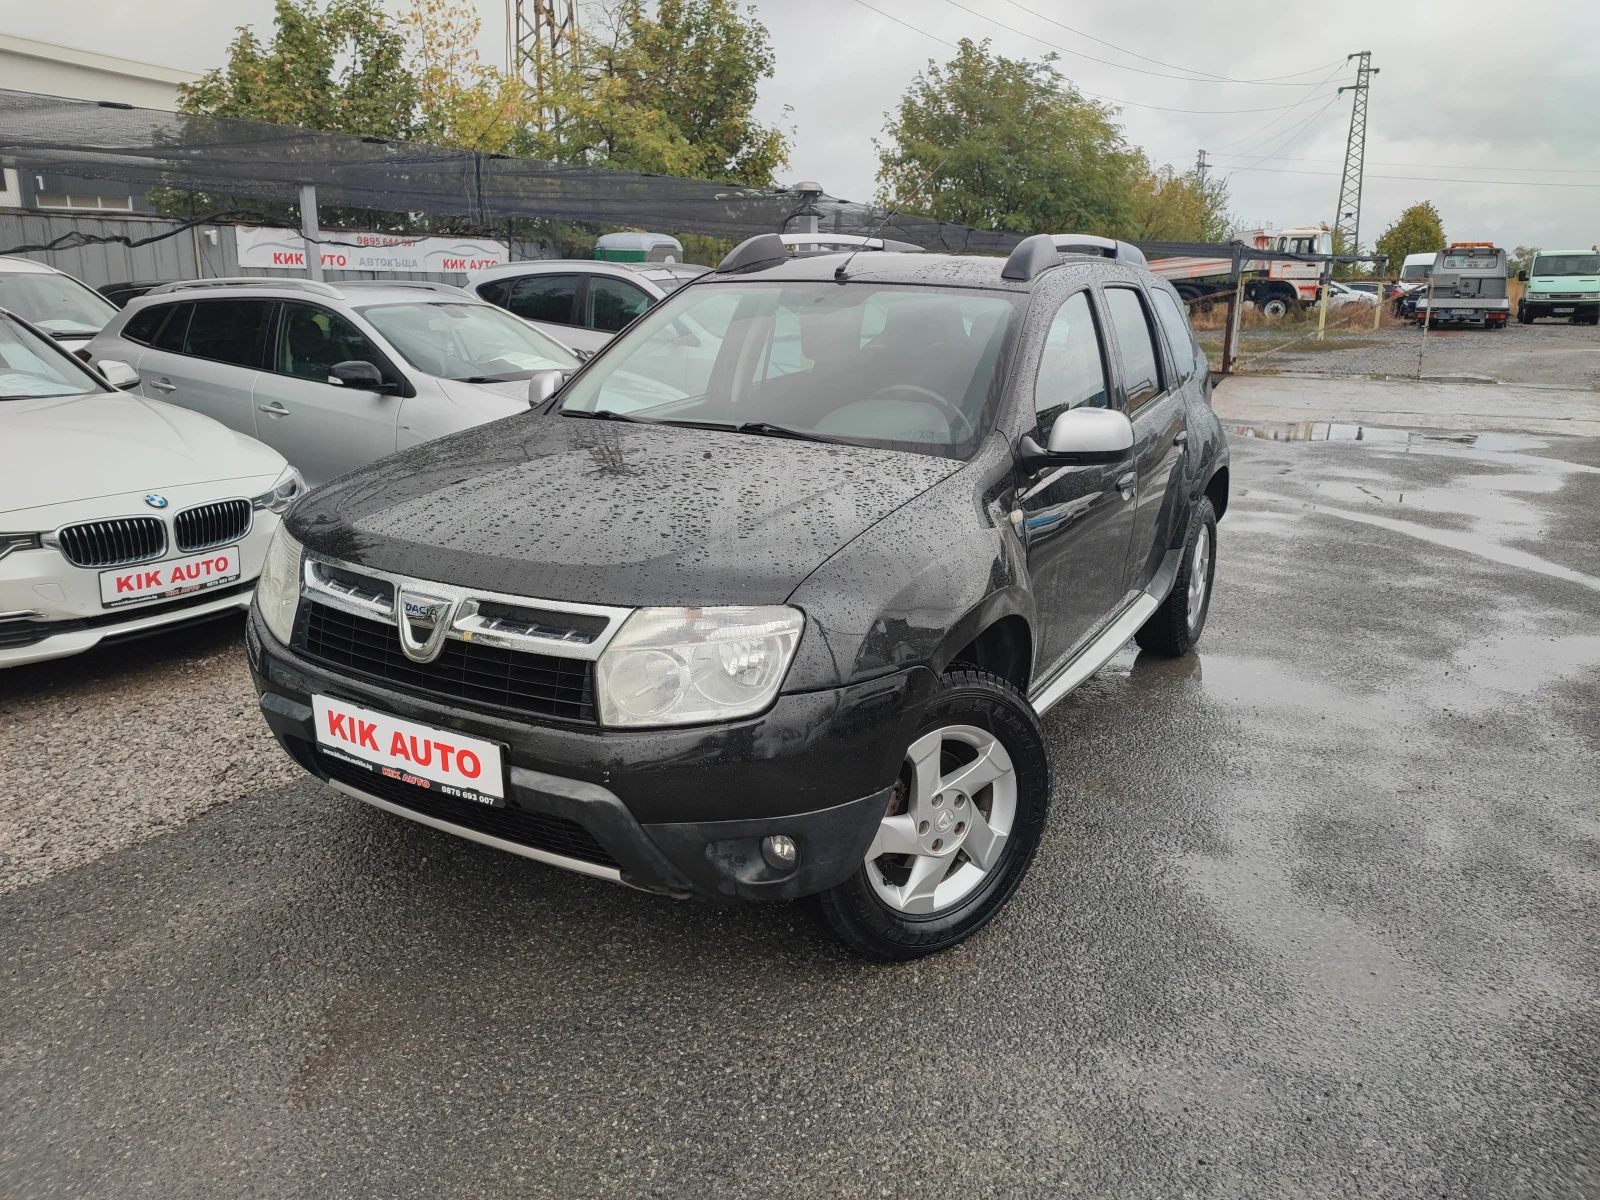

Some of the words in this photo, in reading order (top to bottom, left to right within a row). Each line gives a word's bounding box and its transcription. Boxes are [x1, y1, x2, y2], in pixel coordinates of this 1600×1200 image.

[357, 236, 381, 245] 0895
[273, 252, 304, 265] КИК
[320, 254, 347, 267] УТО
[359, 257, 418, 268] АВТОКЪЩА
[443, 259, 466, 270] КИК
[115, 570, 163, 594] KIK
[170, 556, 229, 583] AUTO
[405, 603, 438, 617] DACIA
[327, 710, 380, 752] KIK
[389, 731, 482, 780] AUTO
[382, 767, 401, 780] KIK
[402, 773, 431, 789] AUTO
[462, 791, 478, 801] 693
[479, 795, 495, 805] 007
